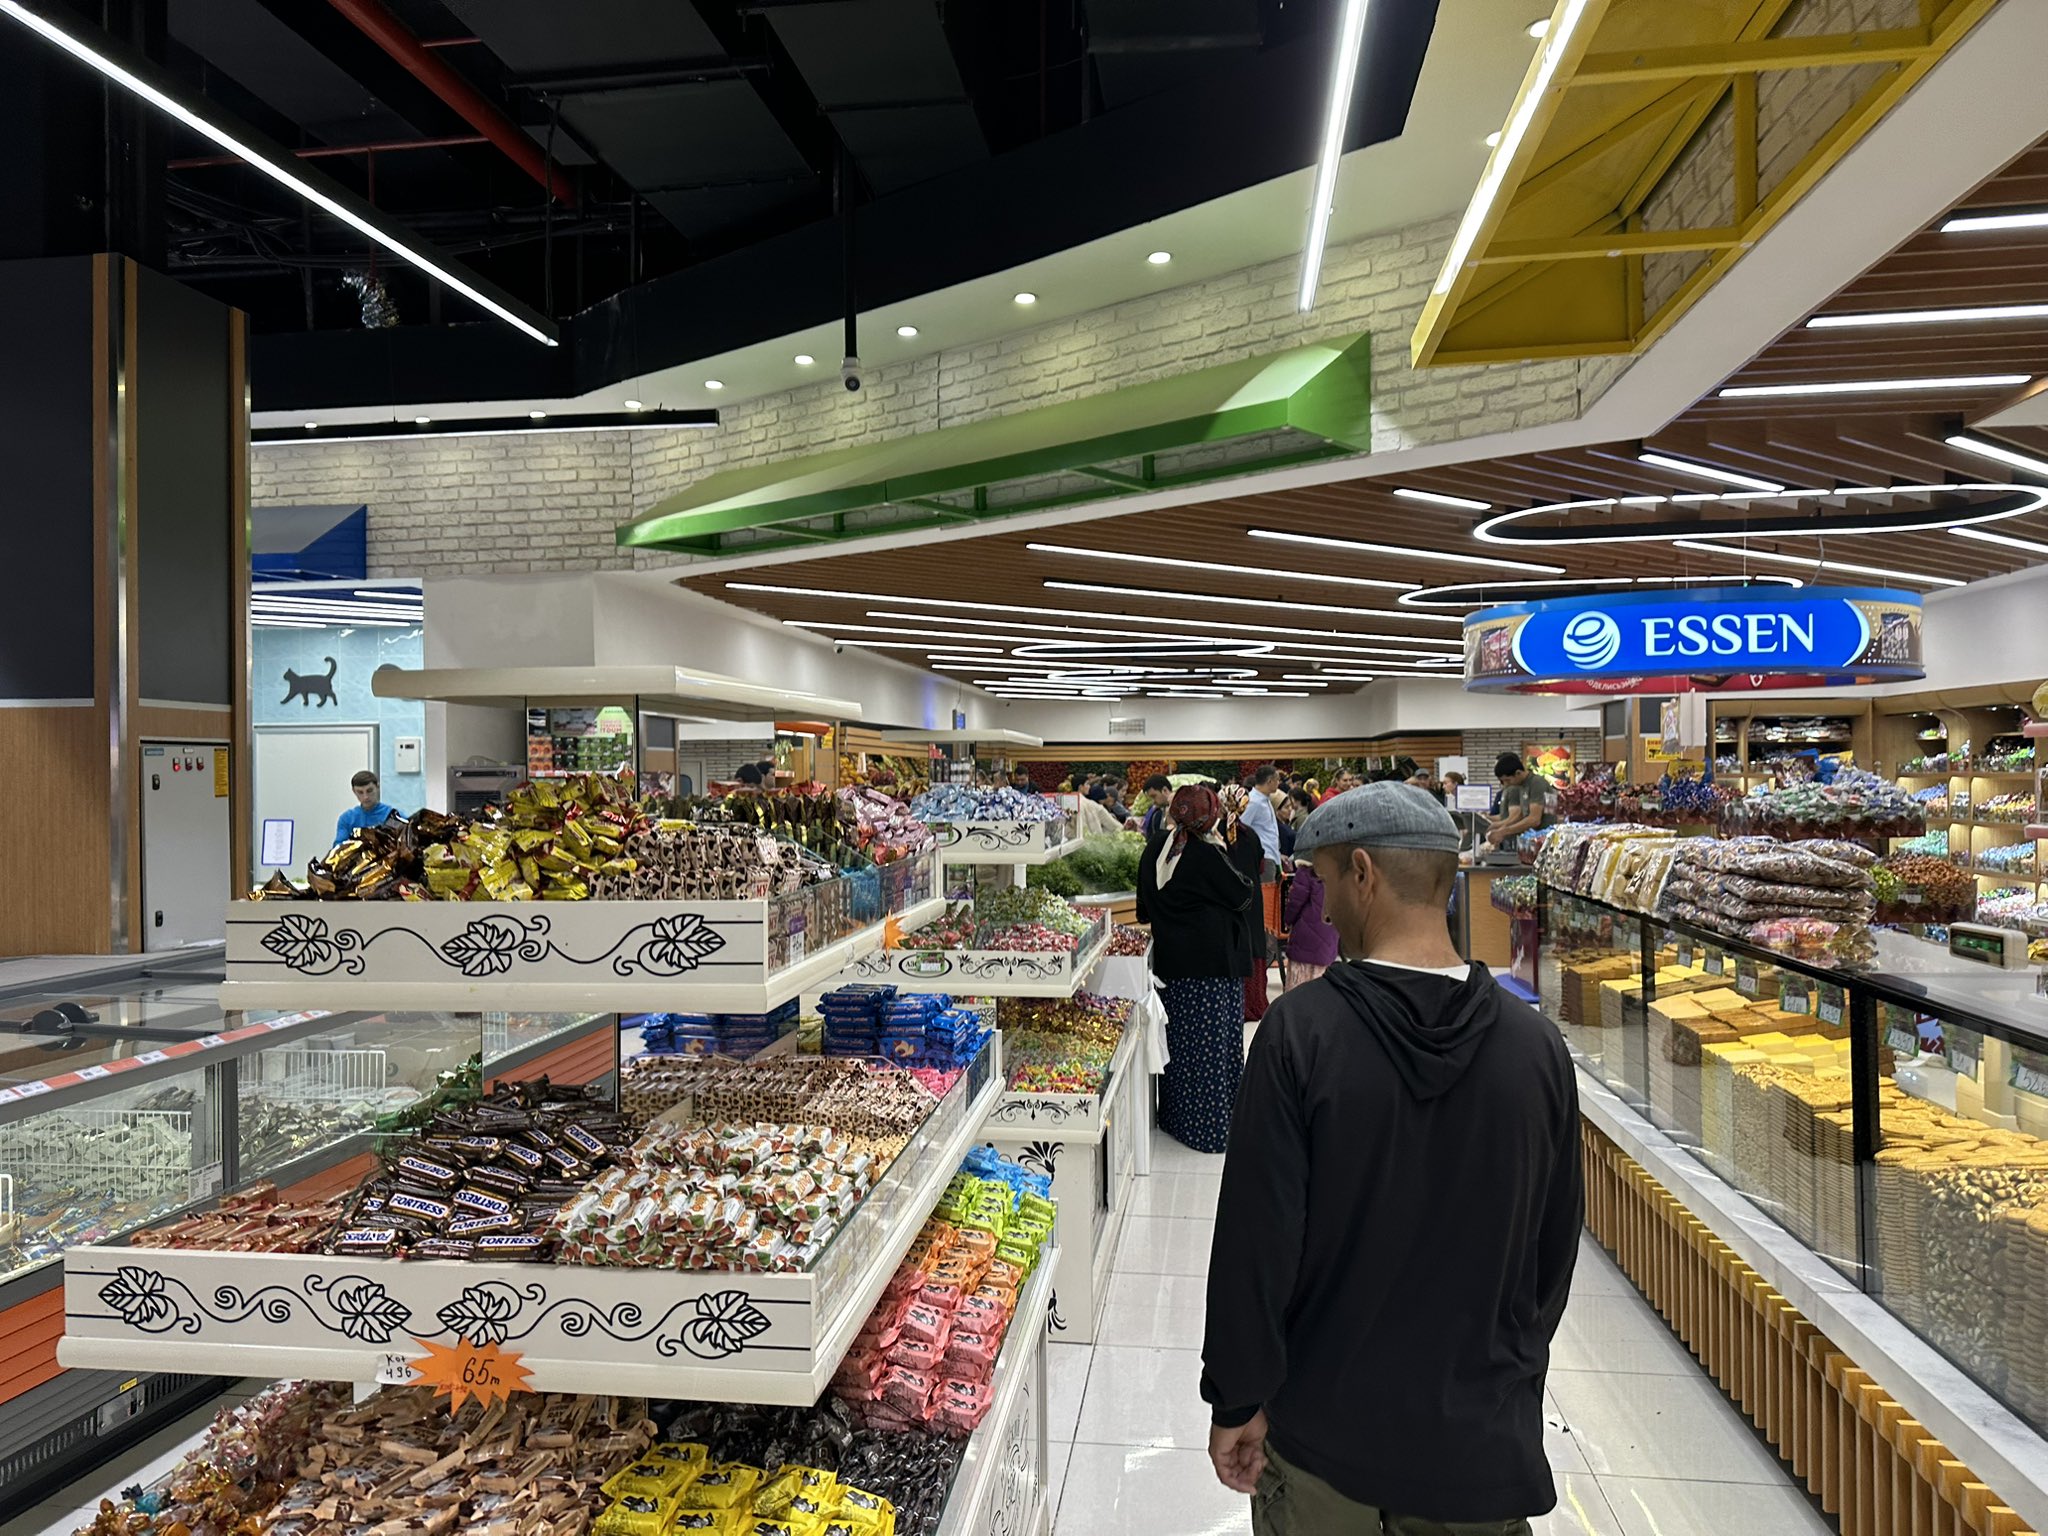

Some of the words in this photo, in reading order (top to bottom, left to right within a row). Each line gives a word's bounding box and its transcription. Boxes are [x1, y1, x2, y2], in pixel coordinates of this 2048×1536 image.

[1641, 613, 1813, 656] ESSEN
[391, 1196, 446, 1216] FORTRESS
[455, 1191, 508, 1214] FORTRESS
[450, 1215, 510, 1231] FORTRESS
[479, 1236, 540, 1245] FORTRESS
